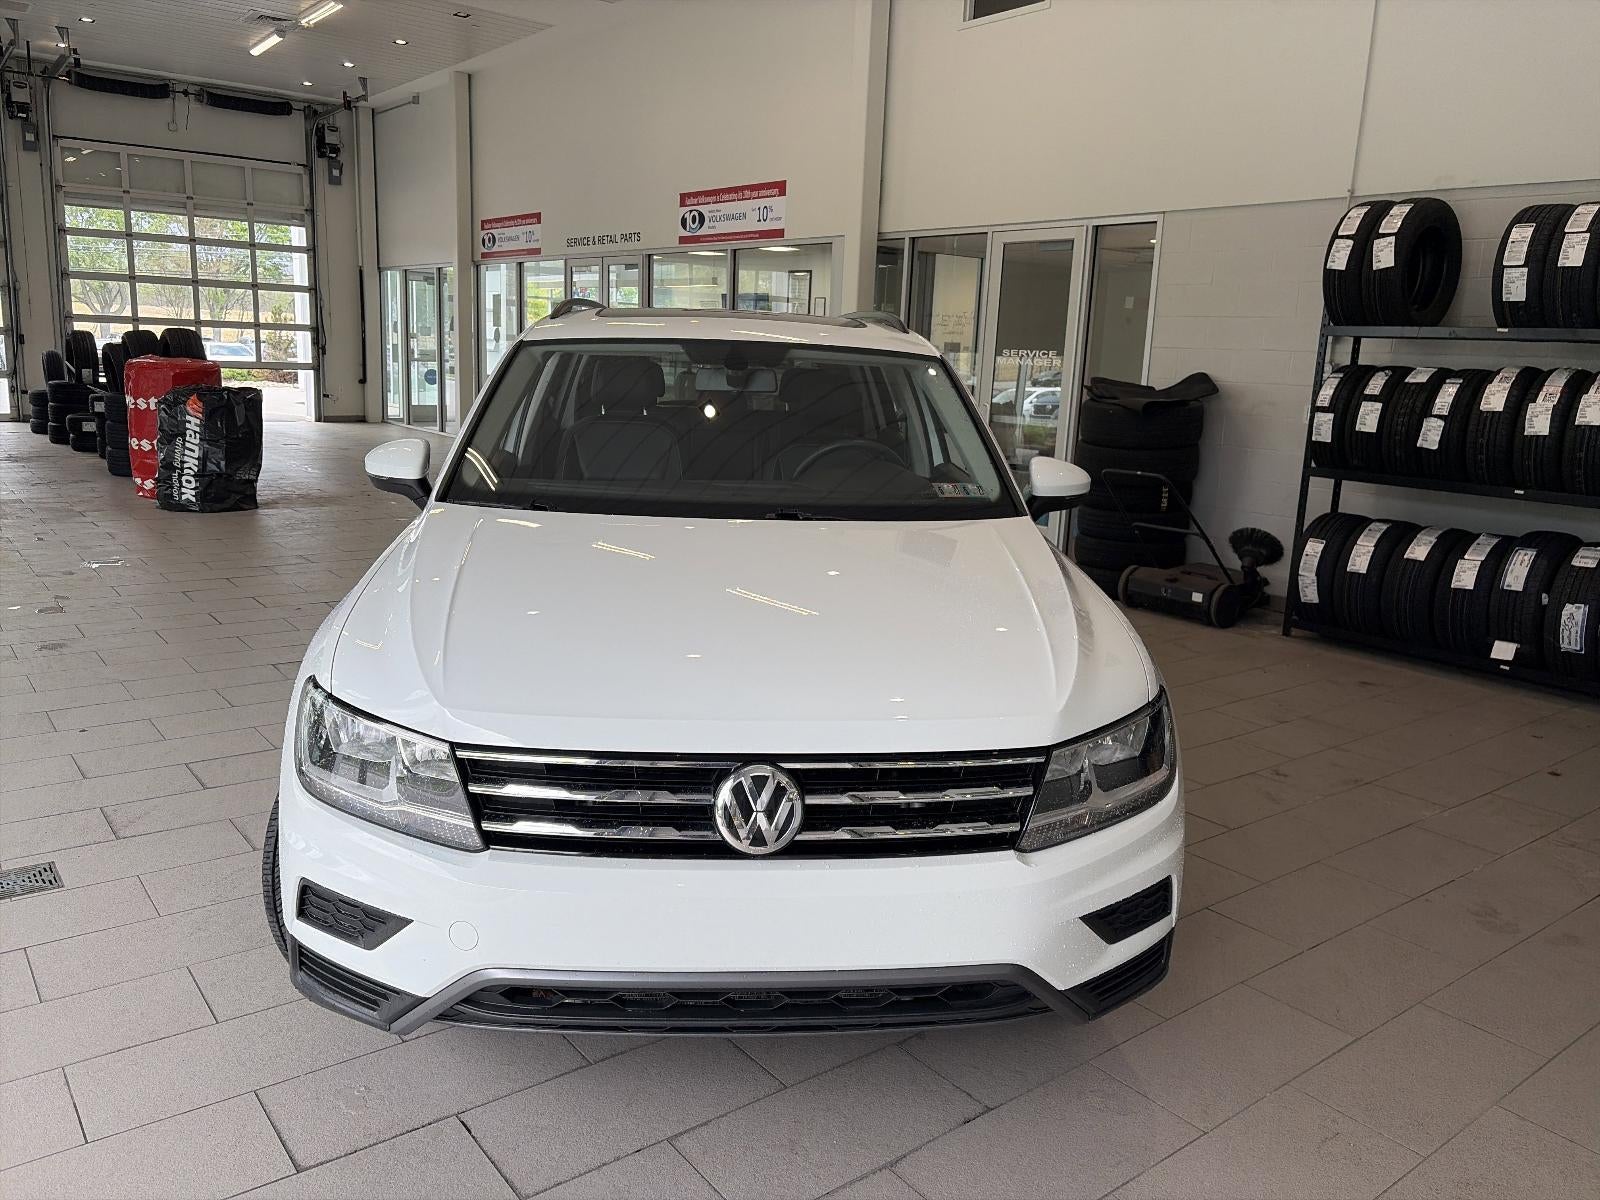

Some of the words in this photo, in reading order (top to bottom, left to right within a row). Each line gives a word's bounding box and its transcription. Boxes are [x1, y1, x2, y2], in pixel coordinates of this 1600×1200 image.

[708, 211, 747, 224] VOLKSWAGEN
[566, 236, 591, 248] SERVICE
[592, 235, 597, 246] &
[597, 233, 619, 246] RETAIL
[620, 231, 641, 243] PARTS
[1002, 349, 1058, 359] SERVICE
[997, 358, 1062, 367] MANAGER
[173, 437, 184, 468] driving
